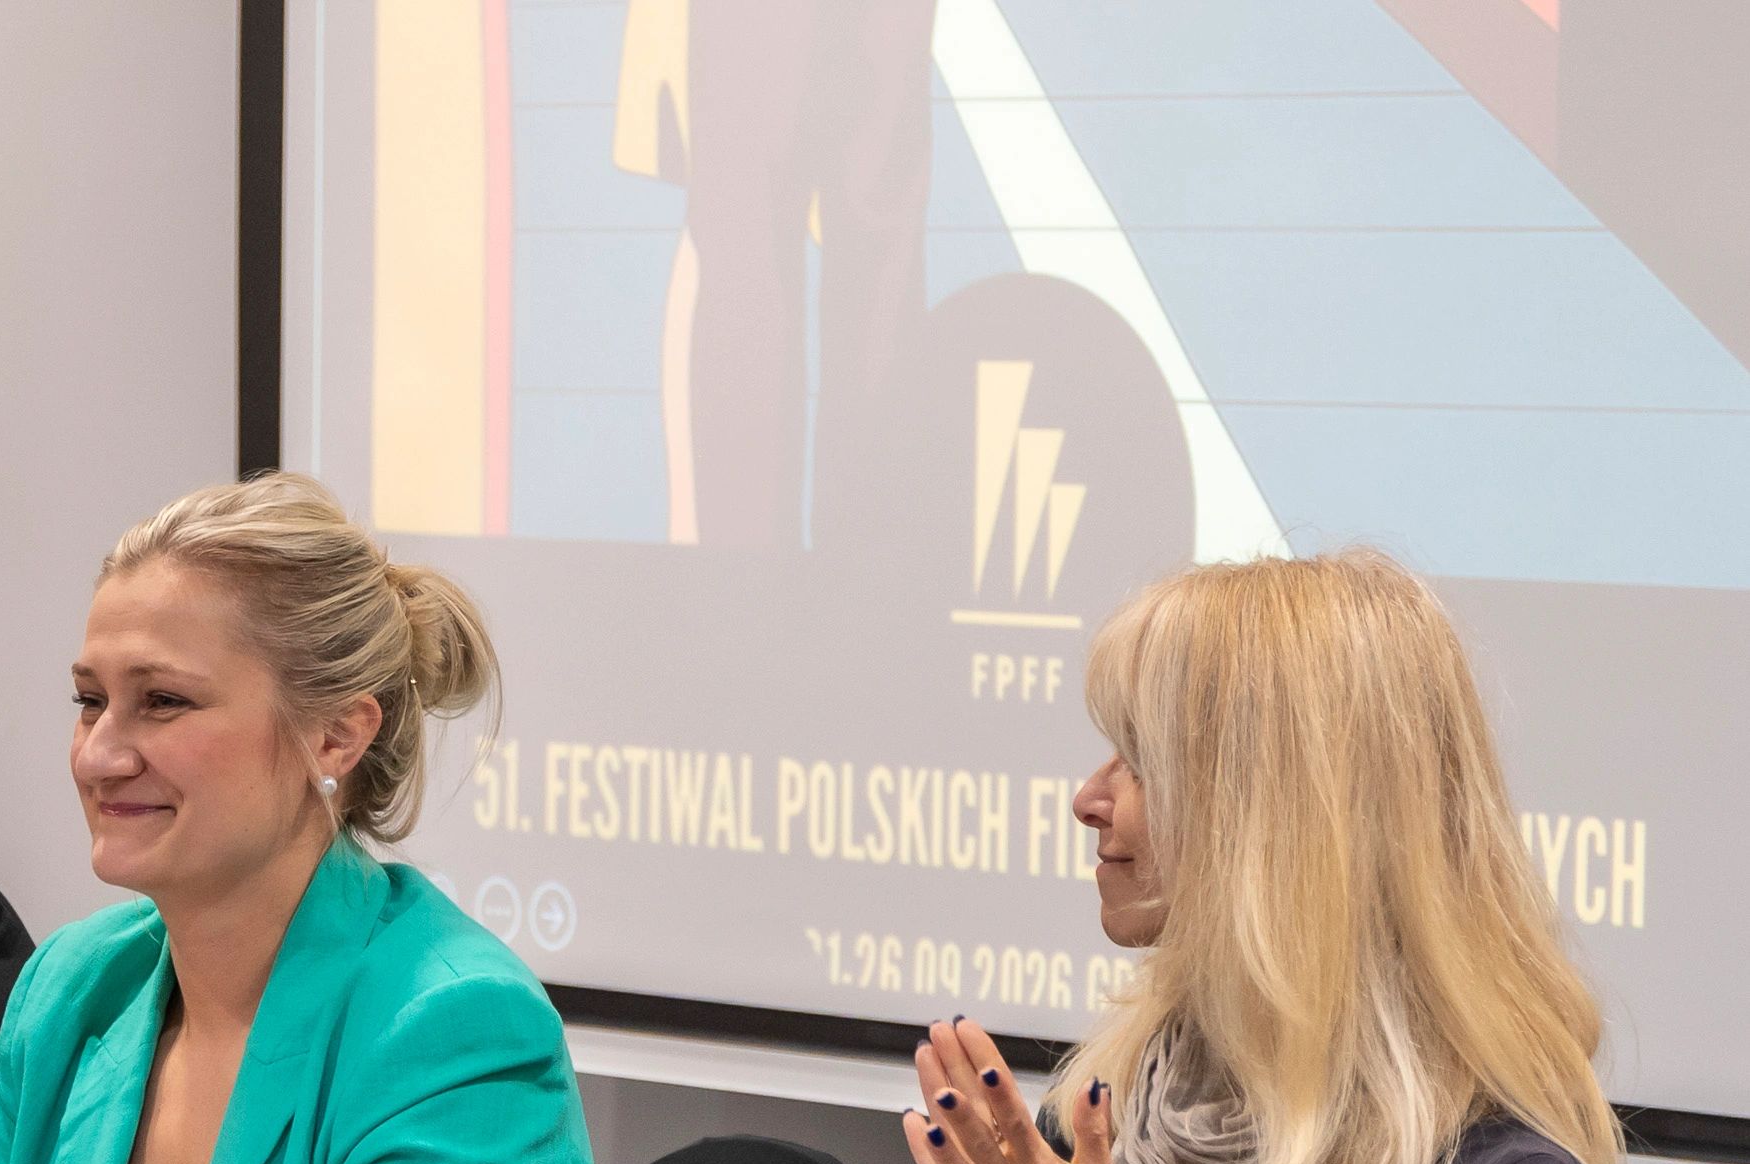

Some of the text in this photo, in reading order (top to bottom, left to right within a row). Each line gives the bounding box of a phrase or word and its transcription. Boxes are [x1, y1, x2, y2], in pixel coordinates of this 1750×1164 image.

[972, 653, 1064, 703] FPFF
[473, 735, 533, 833] 51.
[544, 741, 765, 853] FESTIWAL
[777, 755, 1011, 874] POLSKICH
[1028, 775, 1100, 882] FIL
